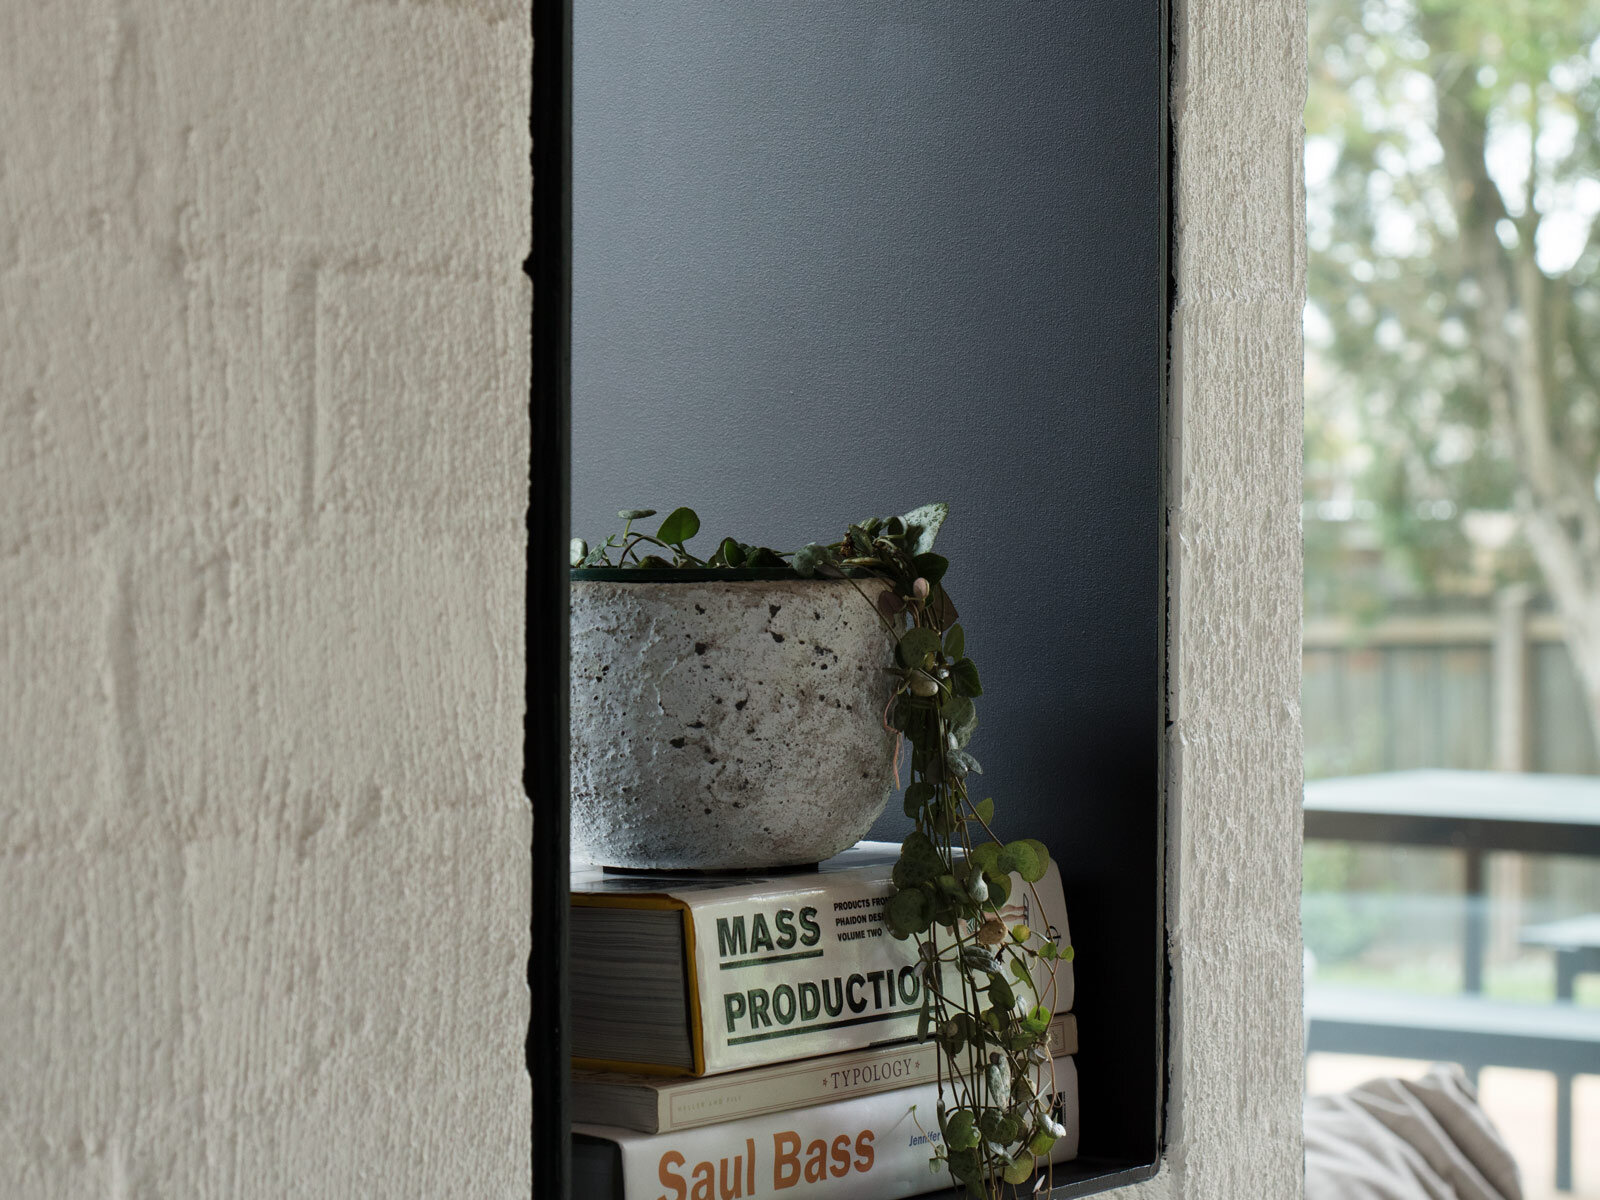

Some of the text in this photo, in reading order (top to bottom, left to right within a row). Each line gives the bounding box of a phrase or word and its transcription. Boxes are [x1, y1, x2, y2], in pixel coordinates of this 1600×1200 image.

[834, 899, 870, 911] PRODUCTS
[836, 915, 867, 926] PHAIDON
[716, 906, 822, 957] MASS
[837, 928, 882, 942] VOLUME TWO
[831, 1058, 912, 1090] TYPOLOGY
[908, 1131, 941, 1147] Jennifer
[773, 1129, 876, 1191] Bass
